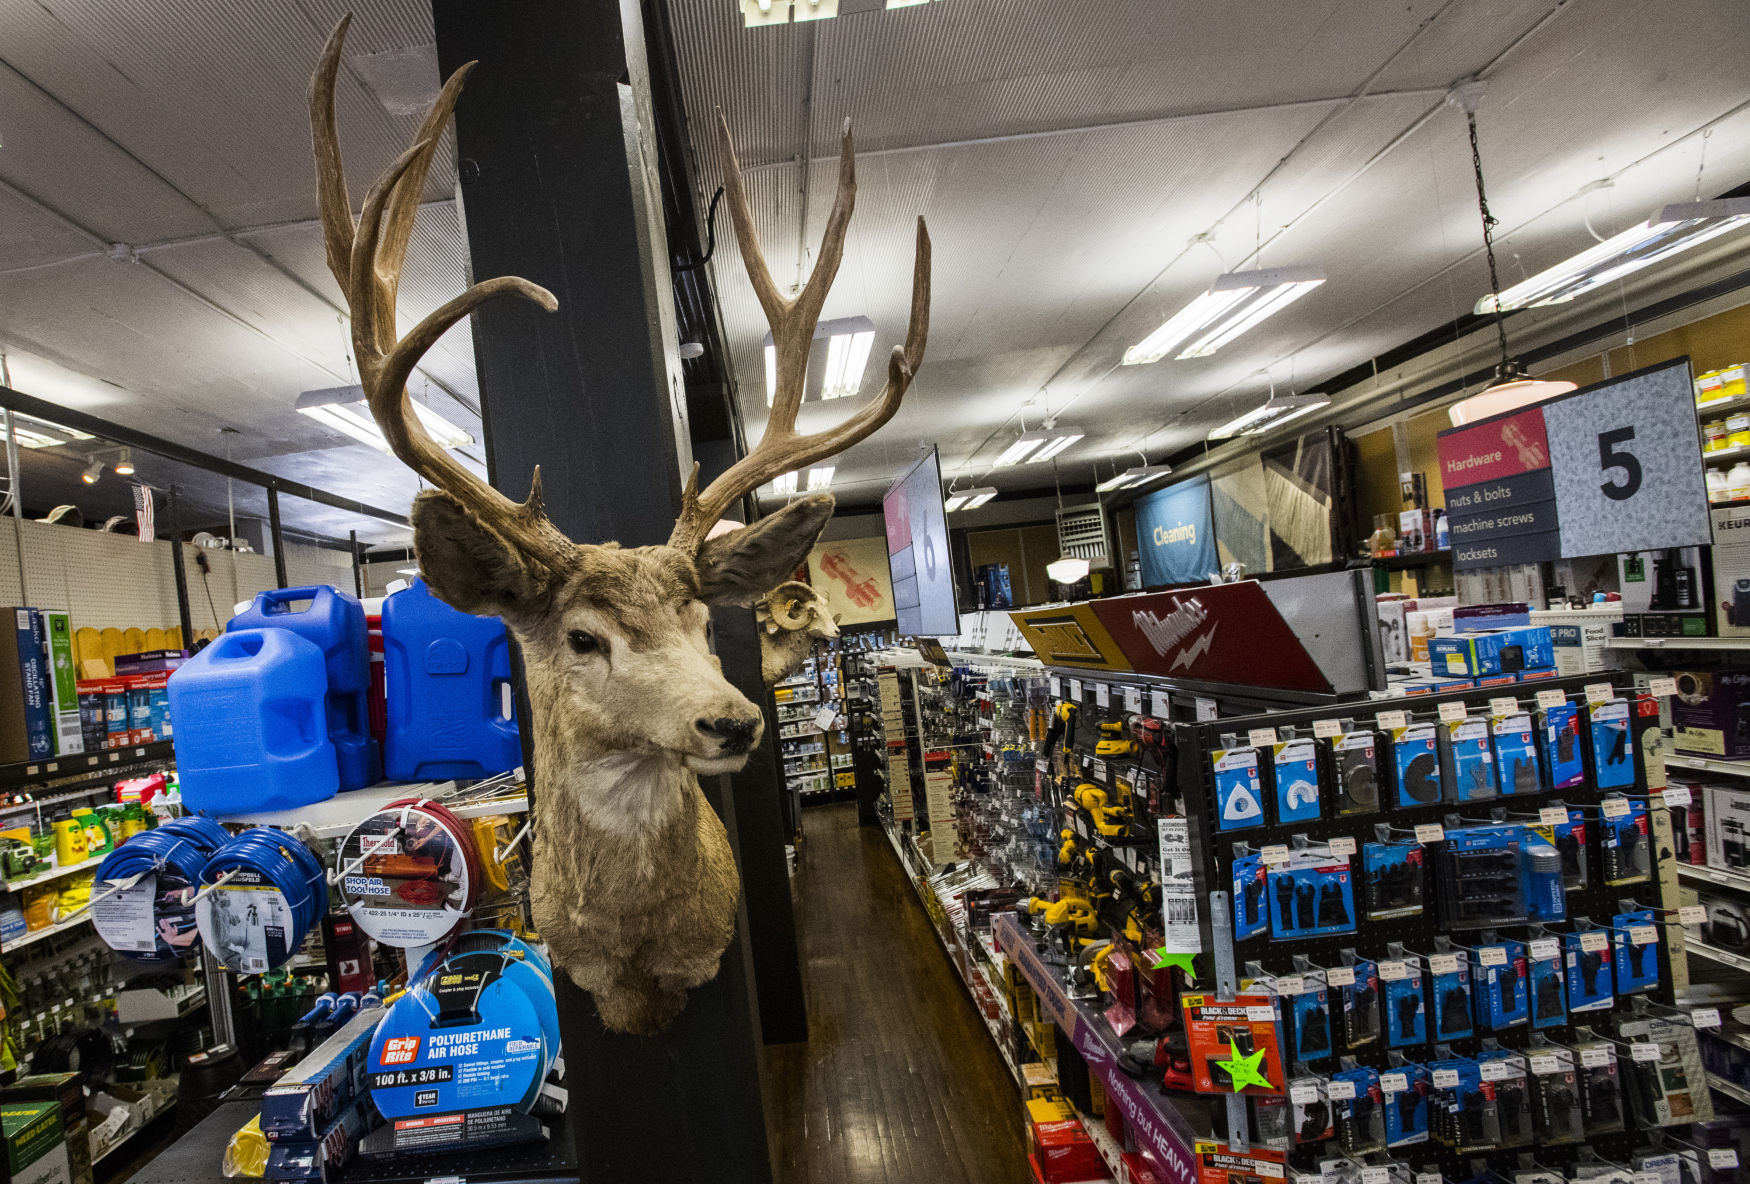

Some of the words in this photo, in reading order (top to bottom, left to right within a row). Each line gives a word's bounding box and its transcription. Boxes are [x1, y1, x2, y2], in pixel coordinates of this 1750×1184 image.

[1447, 451, 1502, 473] Hardware
[1598, 426, 1642, 500] 5
[1450, 495, 1471, 508] nuts
[1474, 491, 1482, 503] &
[1484, 485, 1511, 502] bolts
[1453, 518, 1494, 534] machine
[1497, 513, 1534, 527] screws
[1153, 522, 1196, 547] Cleaning
[923, 509, 936, 582] 6
[1456, 547, 1498, 562] locksets
[30, 658, 42, 709] OSCILLATING
[363, 836, 394, 848] Theroid
[346, 877, 367, 885] SHOP
[387, 1038, 417, 1051] Grip
[429, 1028, 511, 1047] POLYURETHANE
[384, 1051, 413, 1063] Rite
[428, 1047, 447, 1059] AIR
[450, 1044, 478, 1057] HOSE
[376, 1075, 394, 1086] 100
[397, 1073, 408, 1084] ft.
[411, 1073, 417, 1082] x
[420, 1069, 435, 1082] 3/8
[438, 1069, 451, 1079] in.
[417, 1094, 422, 1105] 1
[1107, 1068, 1137, 1119] Nothing
[1137, 1107, 1153, 1137] but
[1152, 1128, 1189, 1182] HEAVY
